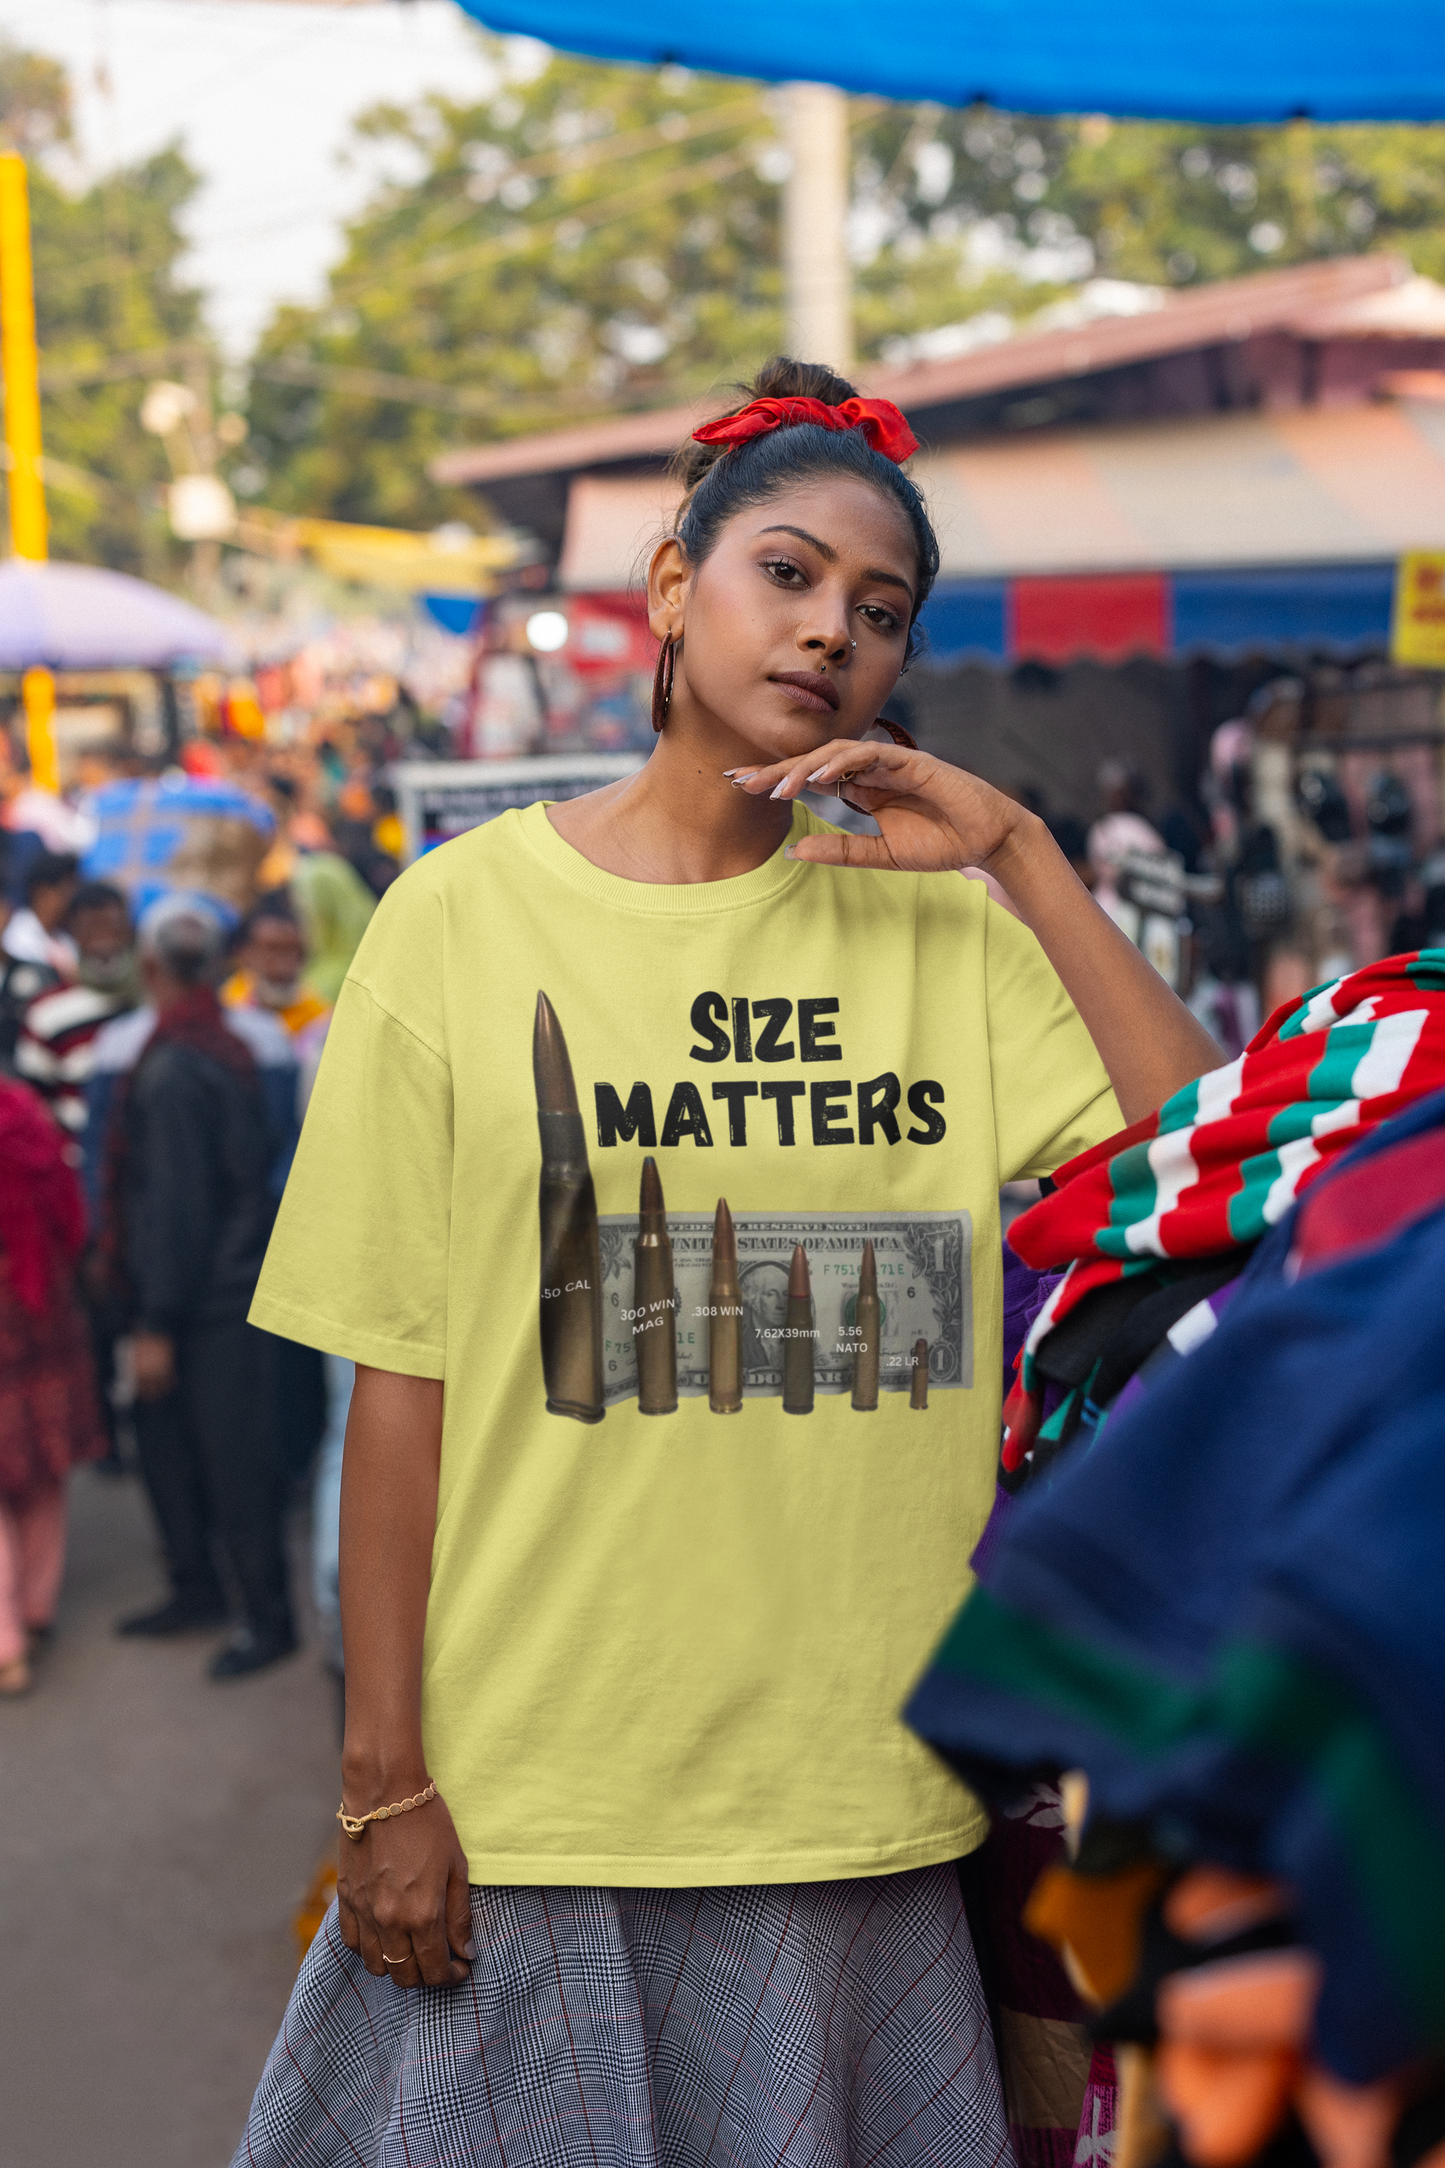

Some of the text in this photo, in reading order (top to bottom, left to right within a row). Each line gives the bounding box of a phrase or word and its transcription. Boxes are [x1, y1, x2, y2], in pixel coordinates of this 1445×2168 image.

[689, 991, 842, 1063] SIZE
[594, 1072, 947, 1147] MATTERS
[738, 1237, 798, 1249] STATES
[803, 1237, 824, 1249] OF
[541, 1280, 591, 1299] .50 CAL
[907, 1286, 916, 1299] 6
[611, 1293, 619, 1308] 6
[620, 1299, 675, 1321] 300 WIN
[692, 1306, 744, 1316] .308 WIN
[632, 1317, 664, 1335] MAG
[838, 1326, 863, 1336] 5.56
[754, 1328, 821, 1338] 7.62X39mm
[836, 1343, 868, 1353] NATO
[608, 1360, 618, 1372] 6
[886, 1356, 919, 1366] .22 LR
